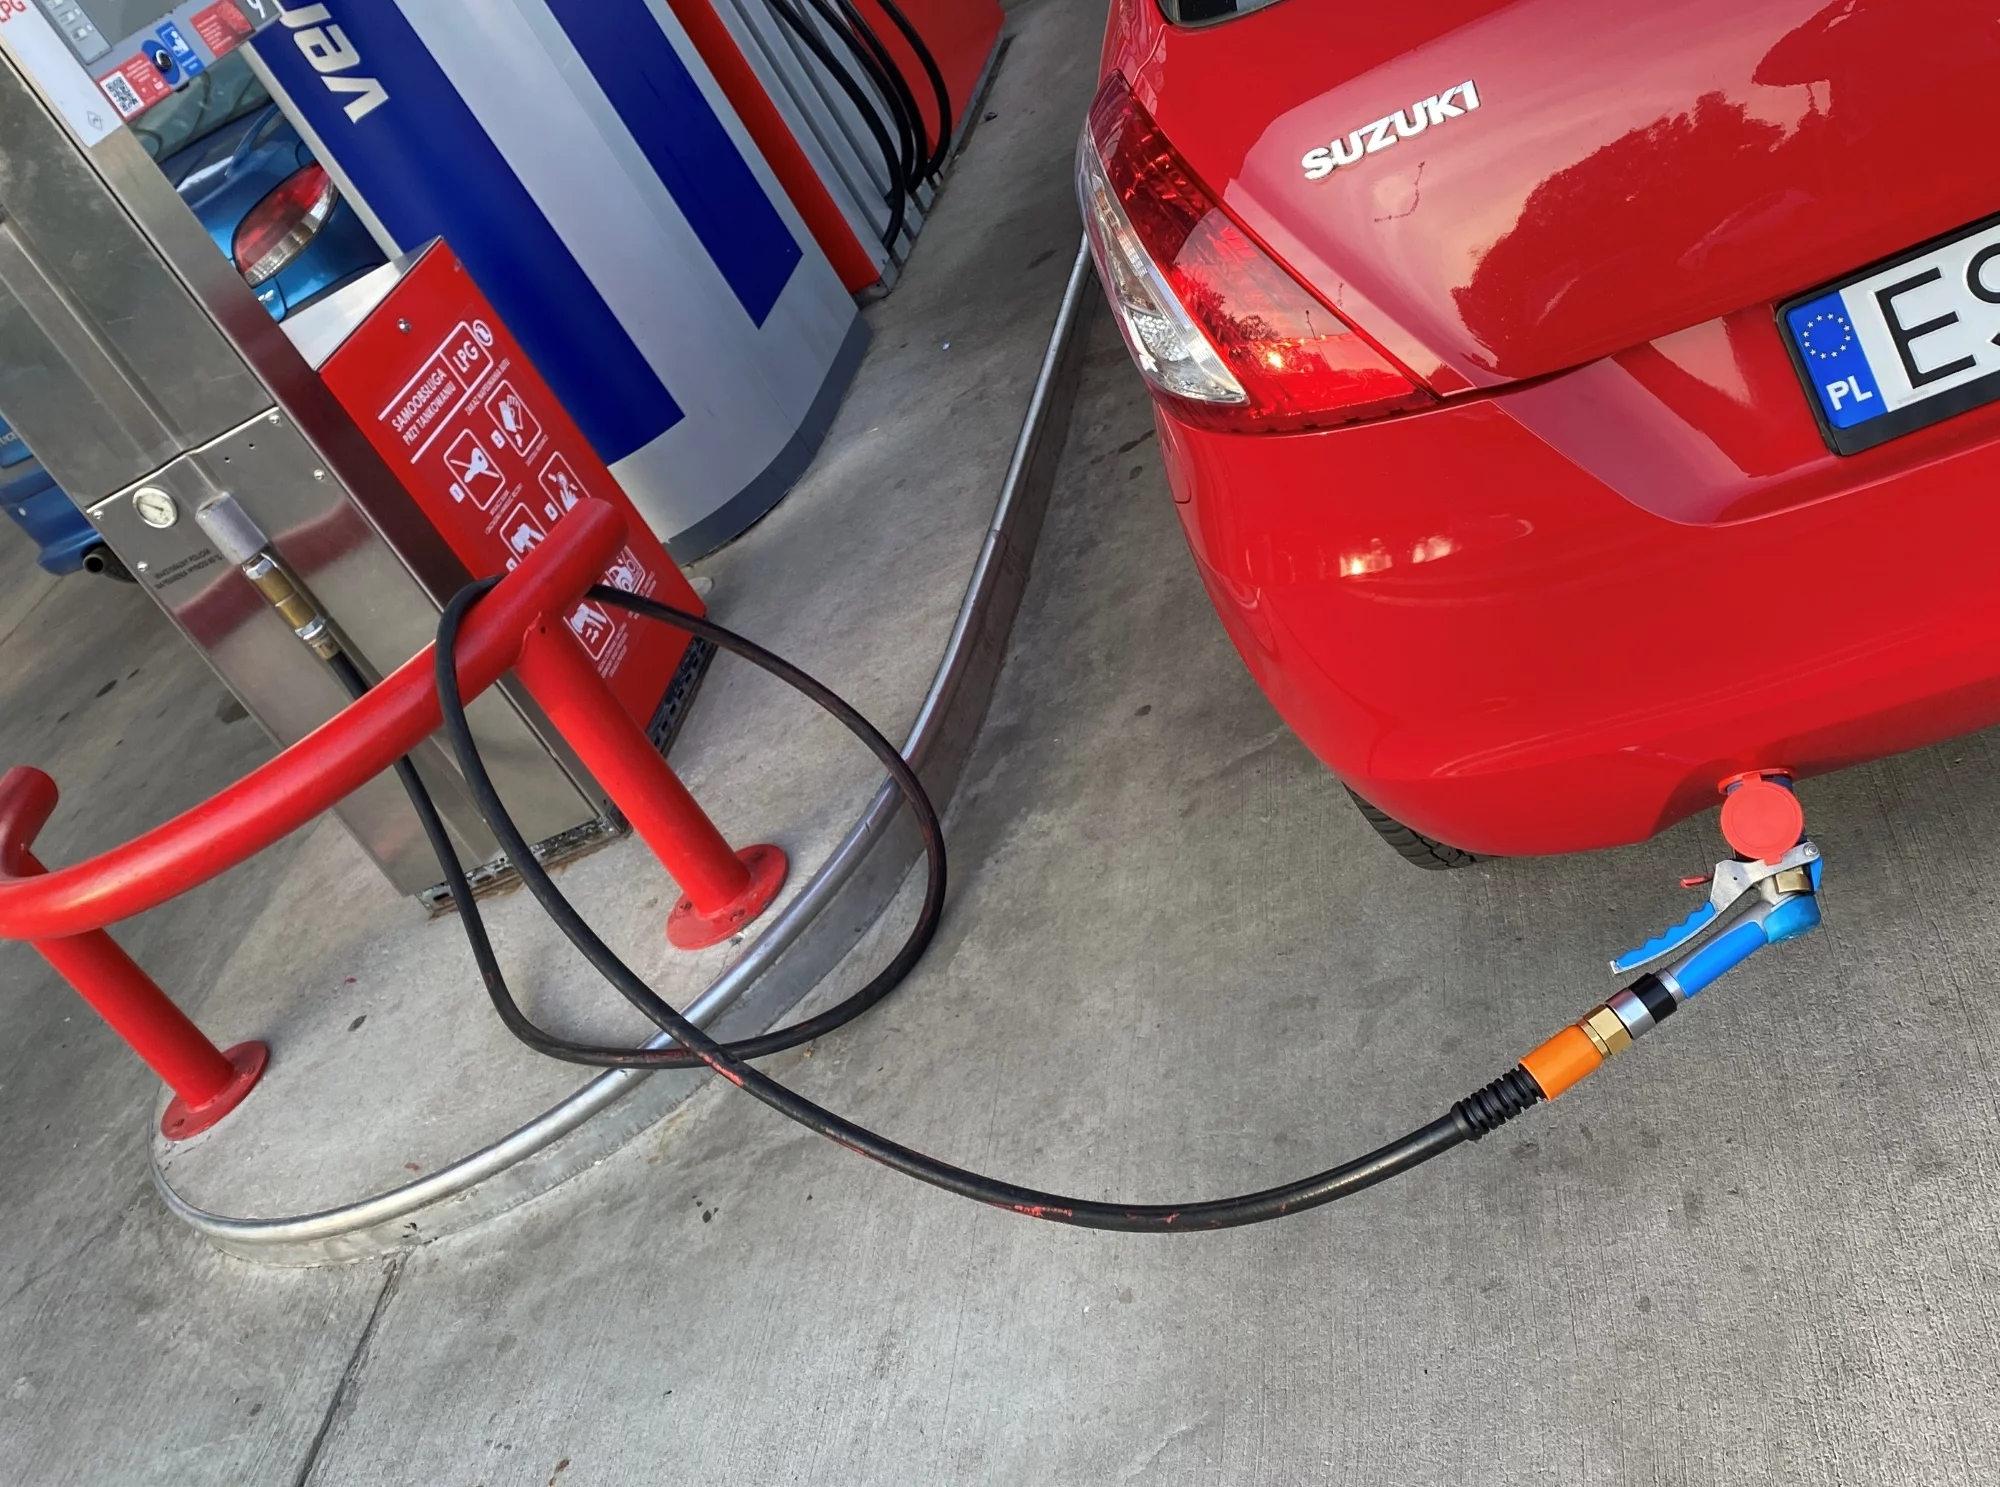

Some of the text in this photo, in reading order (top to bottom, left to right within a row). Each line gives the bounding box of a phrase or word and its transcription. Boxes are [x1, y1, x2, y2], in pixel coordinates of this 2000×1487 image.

[1302, 79, 1481, 180] SUZUKI
[452, 340, 479, 373] LPG
[402, 380, 456, 446] PRZY TANKOWANIU
[1826, 375, 1873, 411] PL
